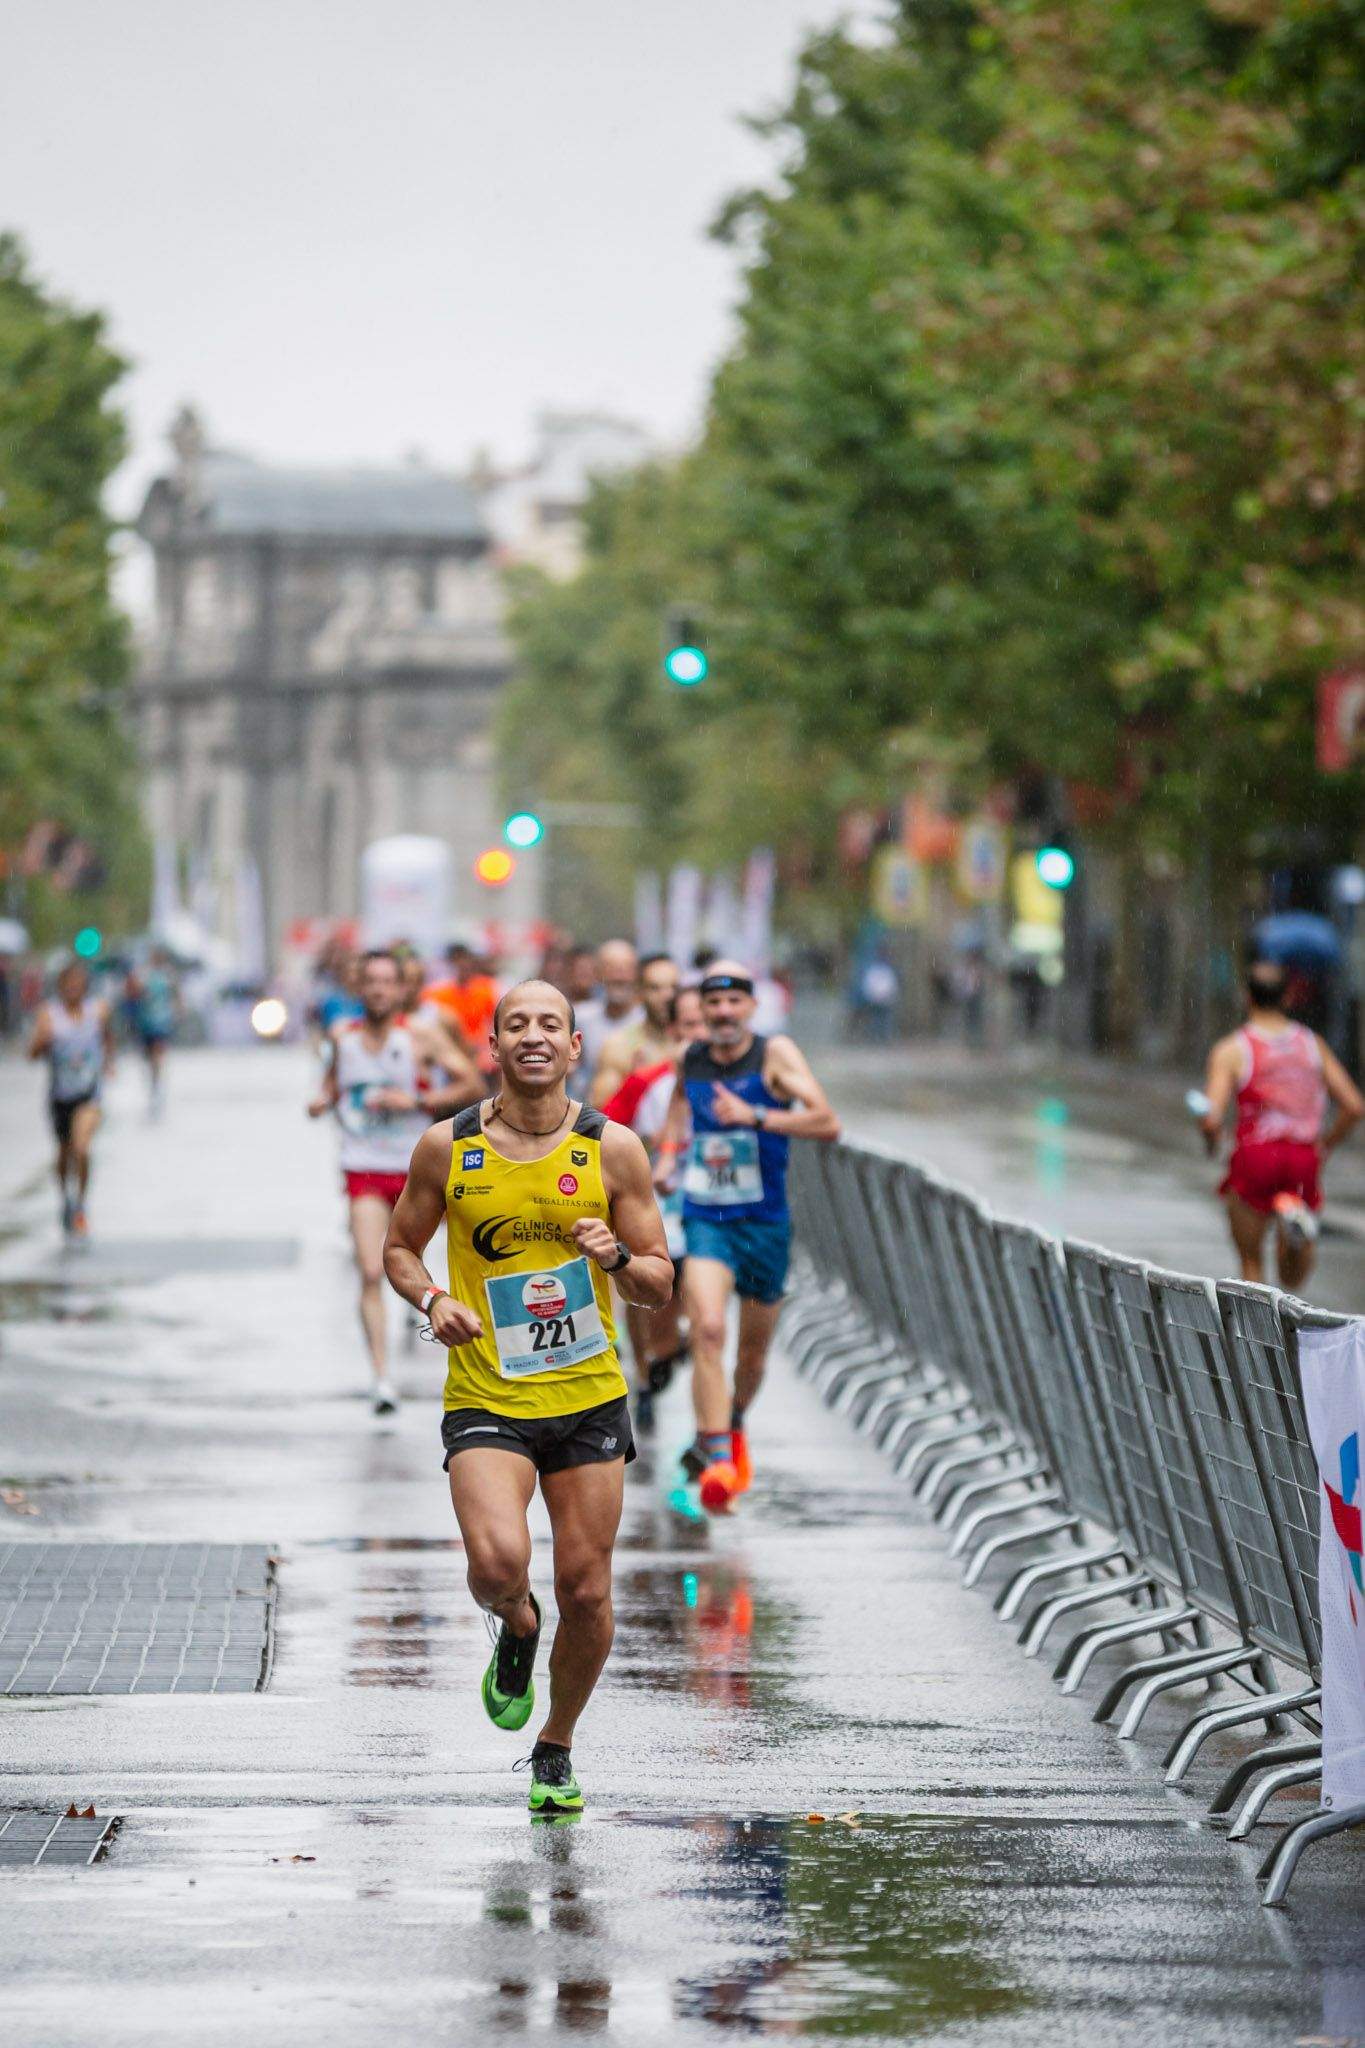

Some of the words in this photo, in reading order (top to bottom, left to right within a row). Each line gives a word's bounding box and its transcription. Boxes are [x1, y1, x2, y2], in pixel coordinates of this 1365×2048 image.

[465, 1153, 482, 1166] ISC
[533, 1197, 601, 1208] LEGALITAS.COM
[513, 1220, 562, 1232] CLÍNICA
[513, 1231, 576, 1244] MENORC
[529, 1314, 577, 1352] 221
